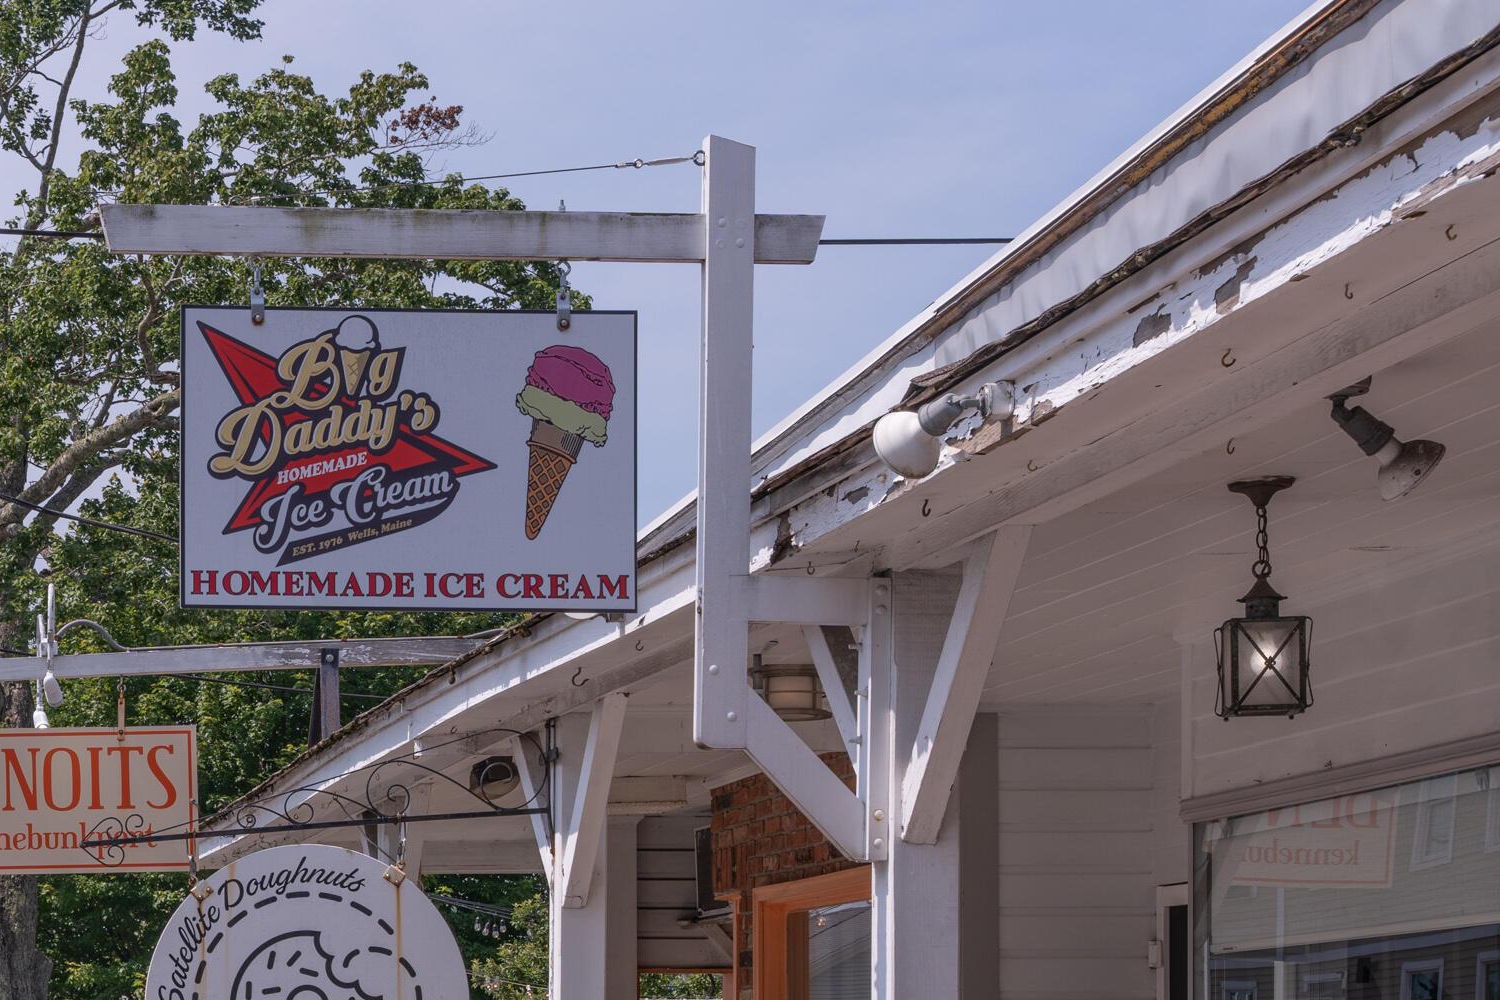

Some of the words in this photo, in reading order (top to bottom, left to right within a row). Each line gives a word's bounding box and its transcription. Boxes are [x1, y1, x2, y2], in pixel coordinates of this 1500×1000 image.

[210, 394, 436, 475] Daddy's
[276, 452, 368, 485] HOMEMADE
[256, 488, 326, 549] Ice
[330, 465, 453, 523] Cream
[292, 543, 316, 557] EST.
[319, 537, 343, 549] 1976
[348, 527, 379, 542] Wells,
[381, 518, 413, 533] Maine
[191, 569, 415, 598] HOMEMADE
[424, 573, 485, 599] ICE
[496, 573, 630, 600] CREAM
[217, 856, 366, 911] Doughnuts
